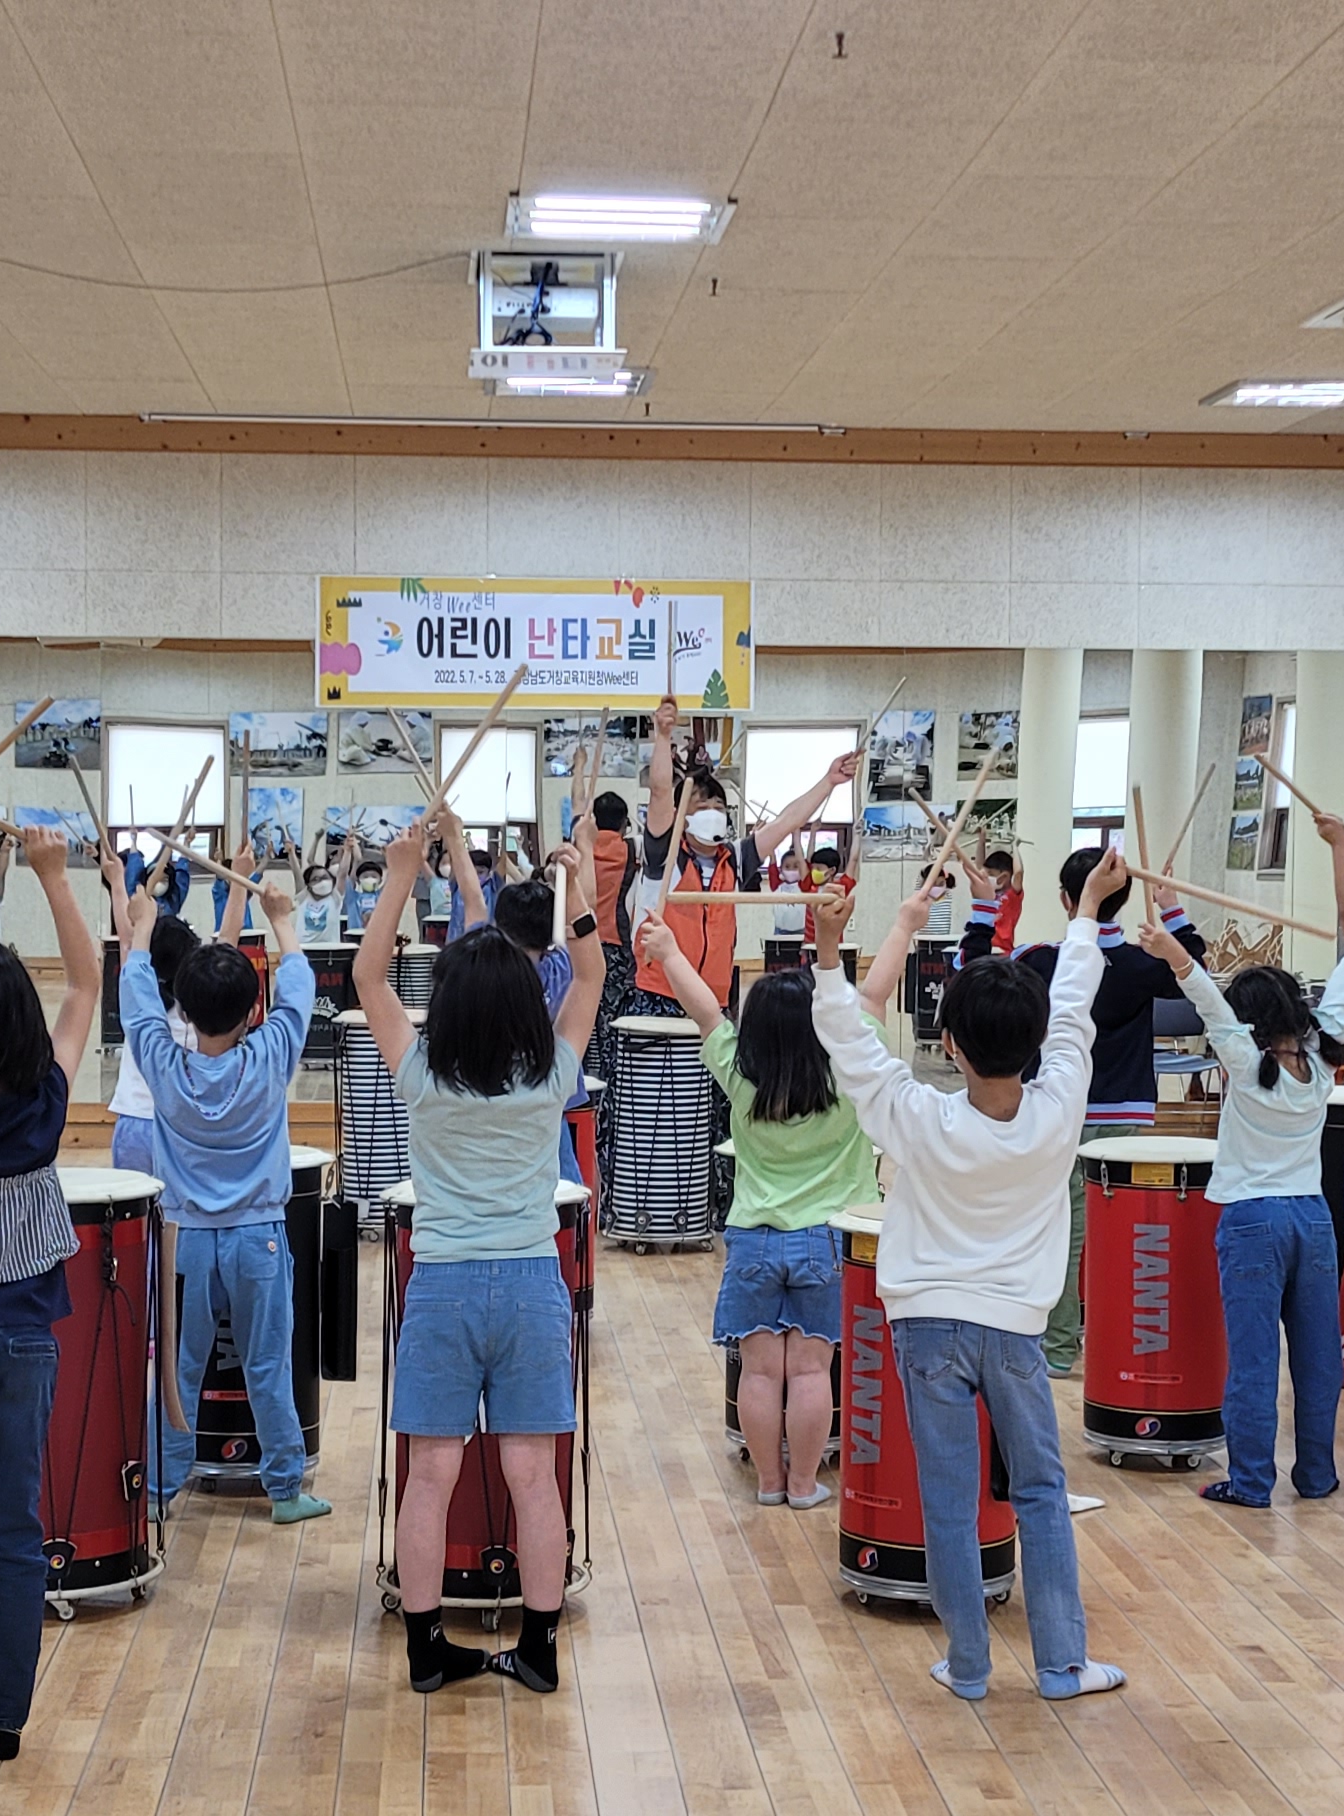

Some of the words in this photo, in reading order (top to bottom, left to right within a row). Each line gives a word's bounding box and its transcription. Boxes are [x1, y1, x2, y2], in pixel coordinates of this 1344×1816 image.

[416, 616, 511, 660] 어린이
[527, 617, 656, 661] 난타교실
[434, 669, 457, 684] 2022.
[1133, 1223, 1170, 1356] NANTA
[850, 1304, 885, 1465] NANTA
